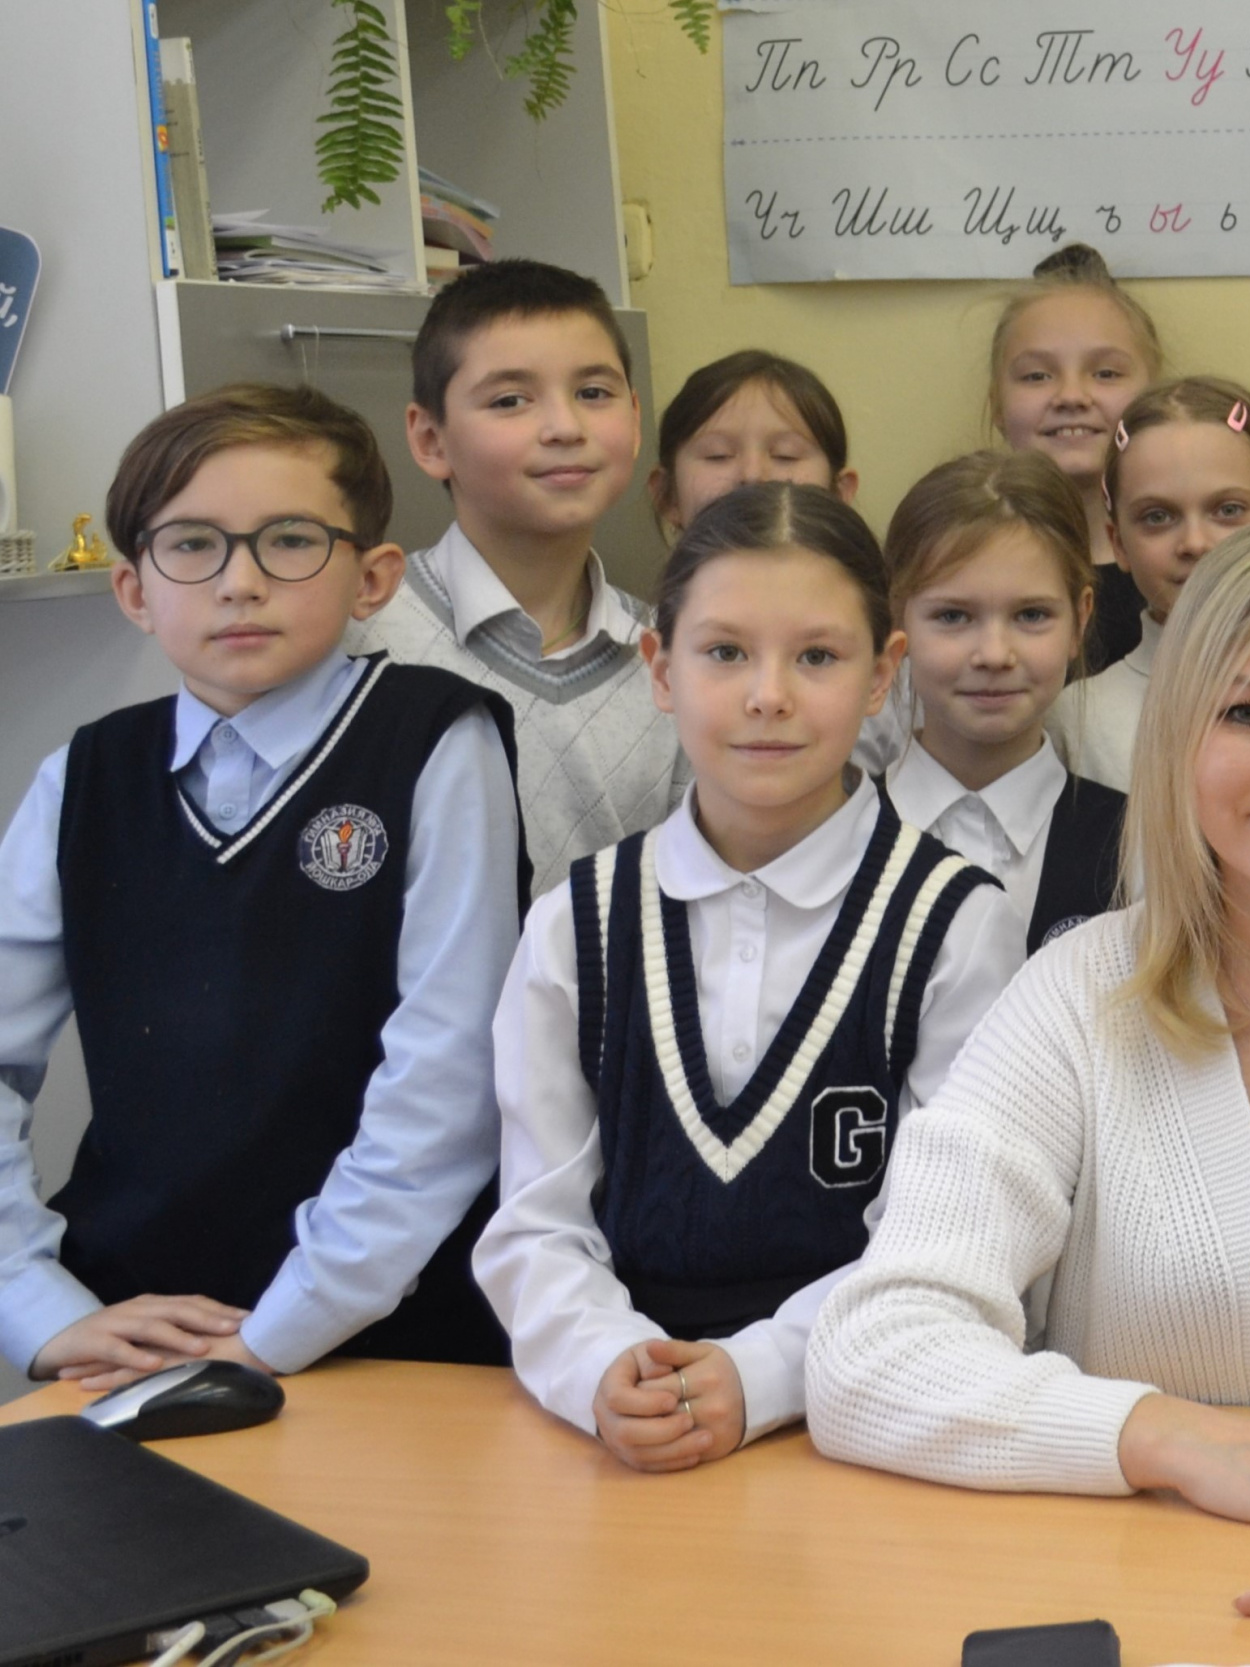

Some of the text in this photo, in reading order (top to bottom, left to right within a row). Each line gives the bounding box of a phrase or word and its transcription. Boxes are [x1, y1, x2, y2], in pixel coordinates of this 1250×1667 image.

[745, 38, 827, 93] Пп
[850, 36, 923, 112] Рр
[944, 33, 1001, 87] Сс
[1024, 29, 1142, 86] Тт
[1164, 27, 1225, 106] Уу
[745, 189, 805, 241] Чч
[831, 186, 934, 237] Шш
[963, 185, 1067, 245] Щщ
[1095, 204, 1122, 235] ъ
[1149, 203, 1192, 233] ы
[1219, 202, 1238, 232] ь
[304, 807, 365, 843] ГИМНАЗИЯ
[304, 861, 381, 888] ЙОШКАР-ОЛА
[809, 1085, 888, 1189] G
